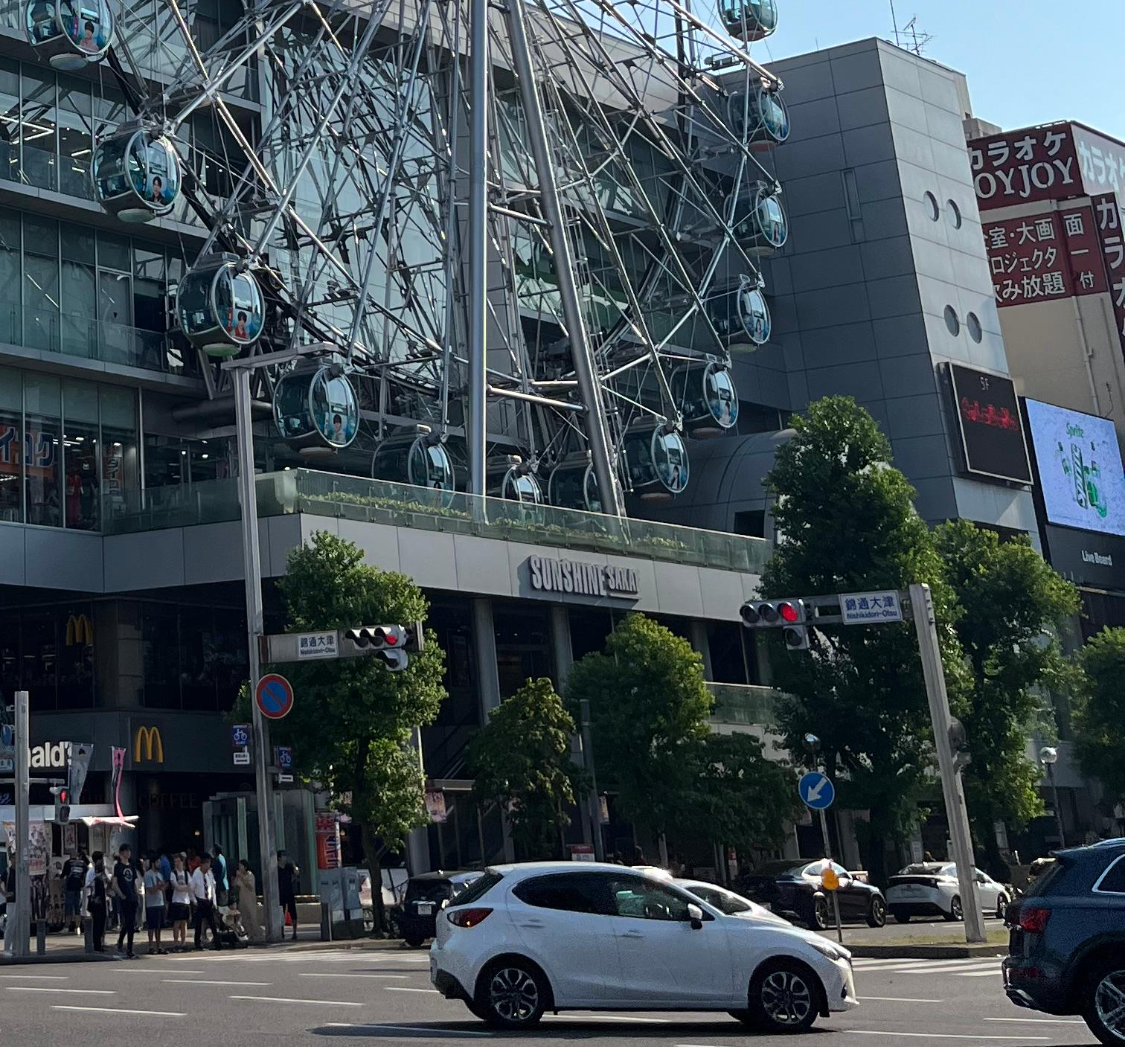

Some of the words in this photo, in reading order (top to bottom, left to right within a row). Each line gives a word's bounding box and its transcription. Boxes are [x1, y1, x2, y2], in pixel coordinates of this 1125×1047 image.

[967, 132, 1071, 170] カラオケ
[973, 156, 1079, 199] OYJOY
[530, 555, 607, 596] SUNSHINE
[845, 596, 895, 611] 錦通大津
